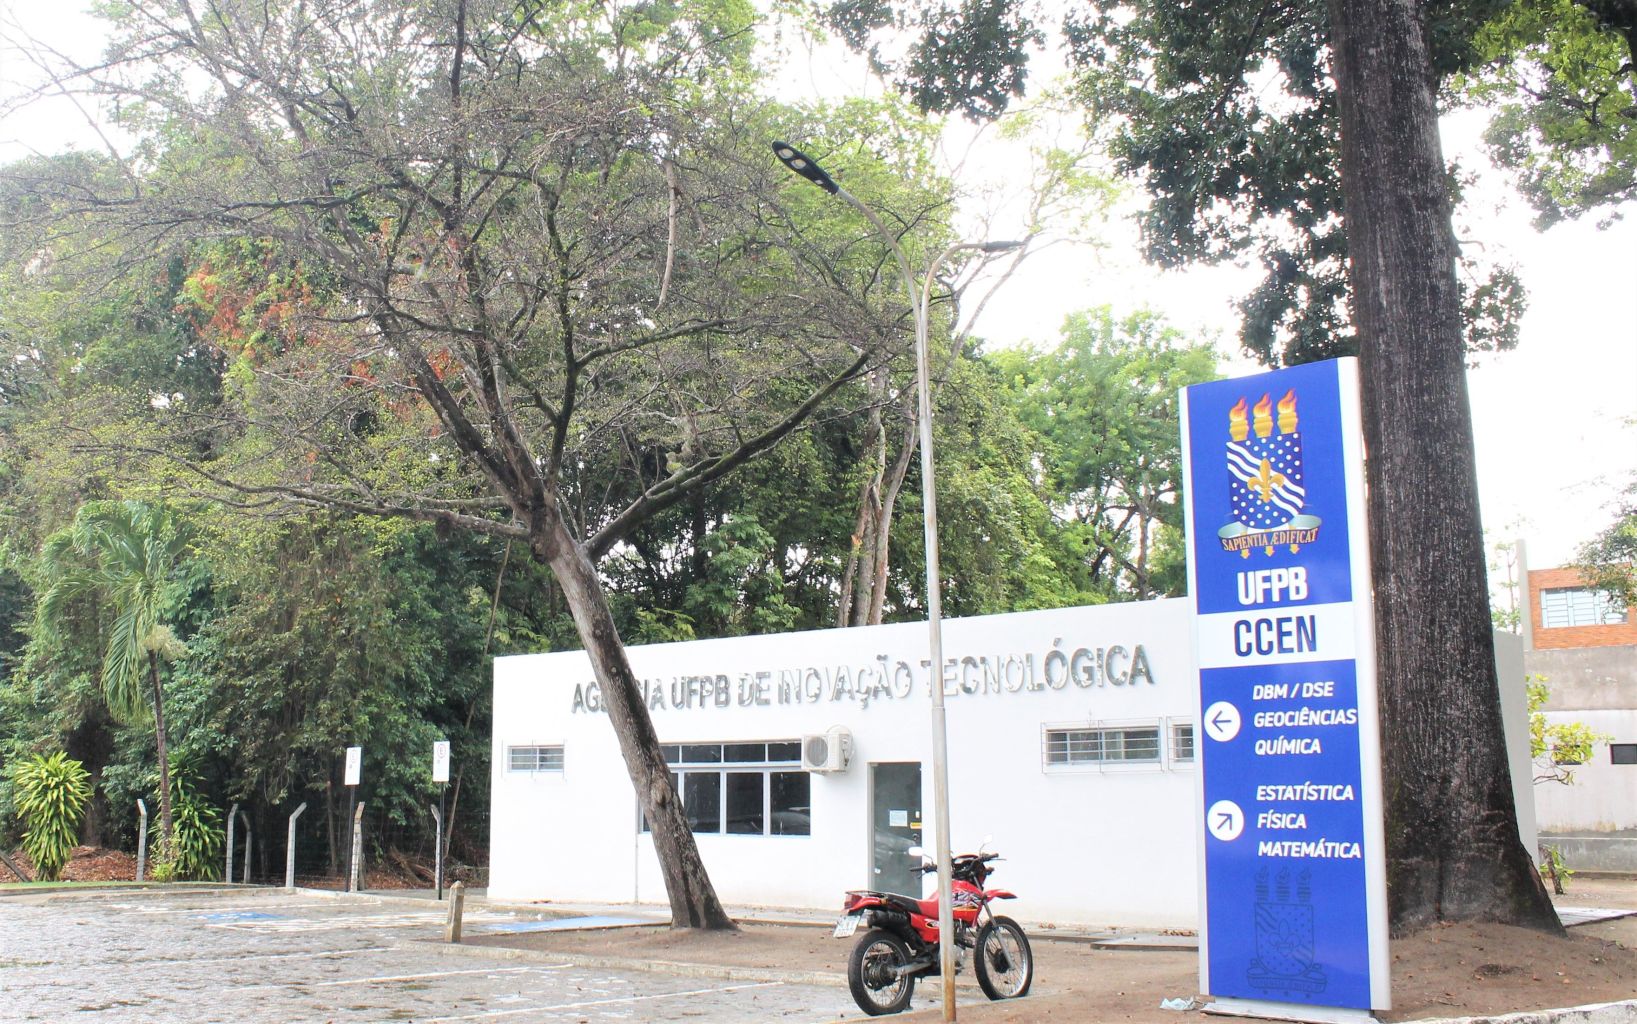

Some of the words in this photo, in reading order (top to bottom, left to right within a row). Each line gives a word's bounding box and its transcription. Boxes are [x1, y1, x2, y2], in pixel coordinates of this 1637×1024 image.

[1222, 533, 1268, 551] SAPIENTIA
[1270, 528, 1318, 545] ÆDIFICAT
[1237, 566, 1308, 605] UFPB
[1234, 615, 1317, 657] CCEN
[671, 674, 731, 710] UFPB
[738, 671, 771, 707] DE
[778, 654, 912, 710] INOVAÇÃO
[1253, 684, 1288, 700] DBM
[1290, 683, 1300, 699] /
[1302, 682, 1334, 698] DSE
[1254, 707, 1357, 727] GEOCIÊNCIAS
[1255, 735, 1321, 755] QUÍMICA
[1256, 781, 1354, 801] ESTATÍSTICA
[1257, 809, 1307, 829] FÍSICA
[1258, 838, 1361, 858] MATEMÁTICA
